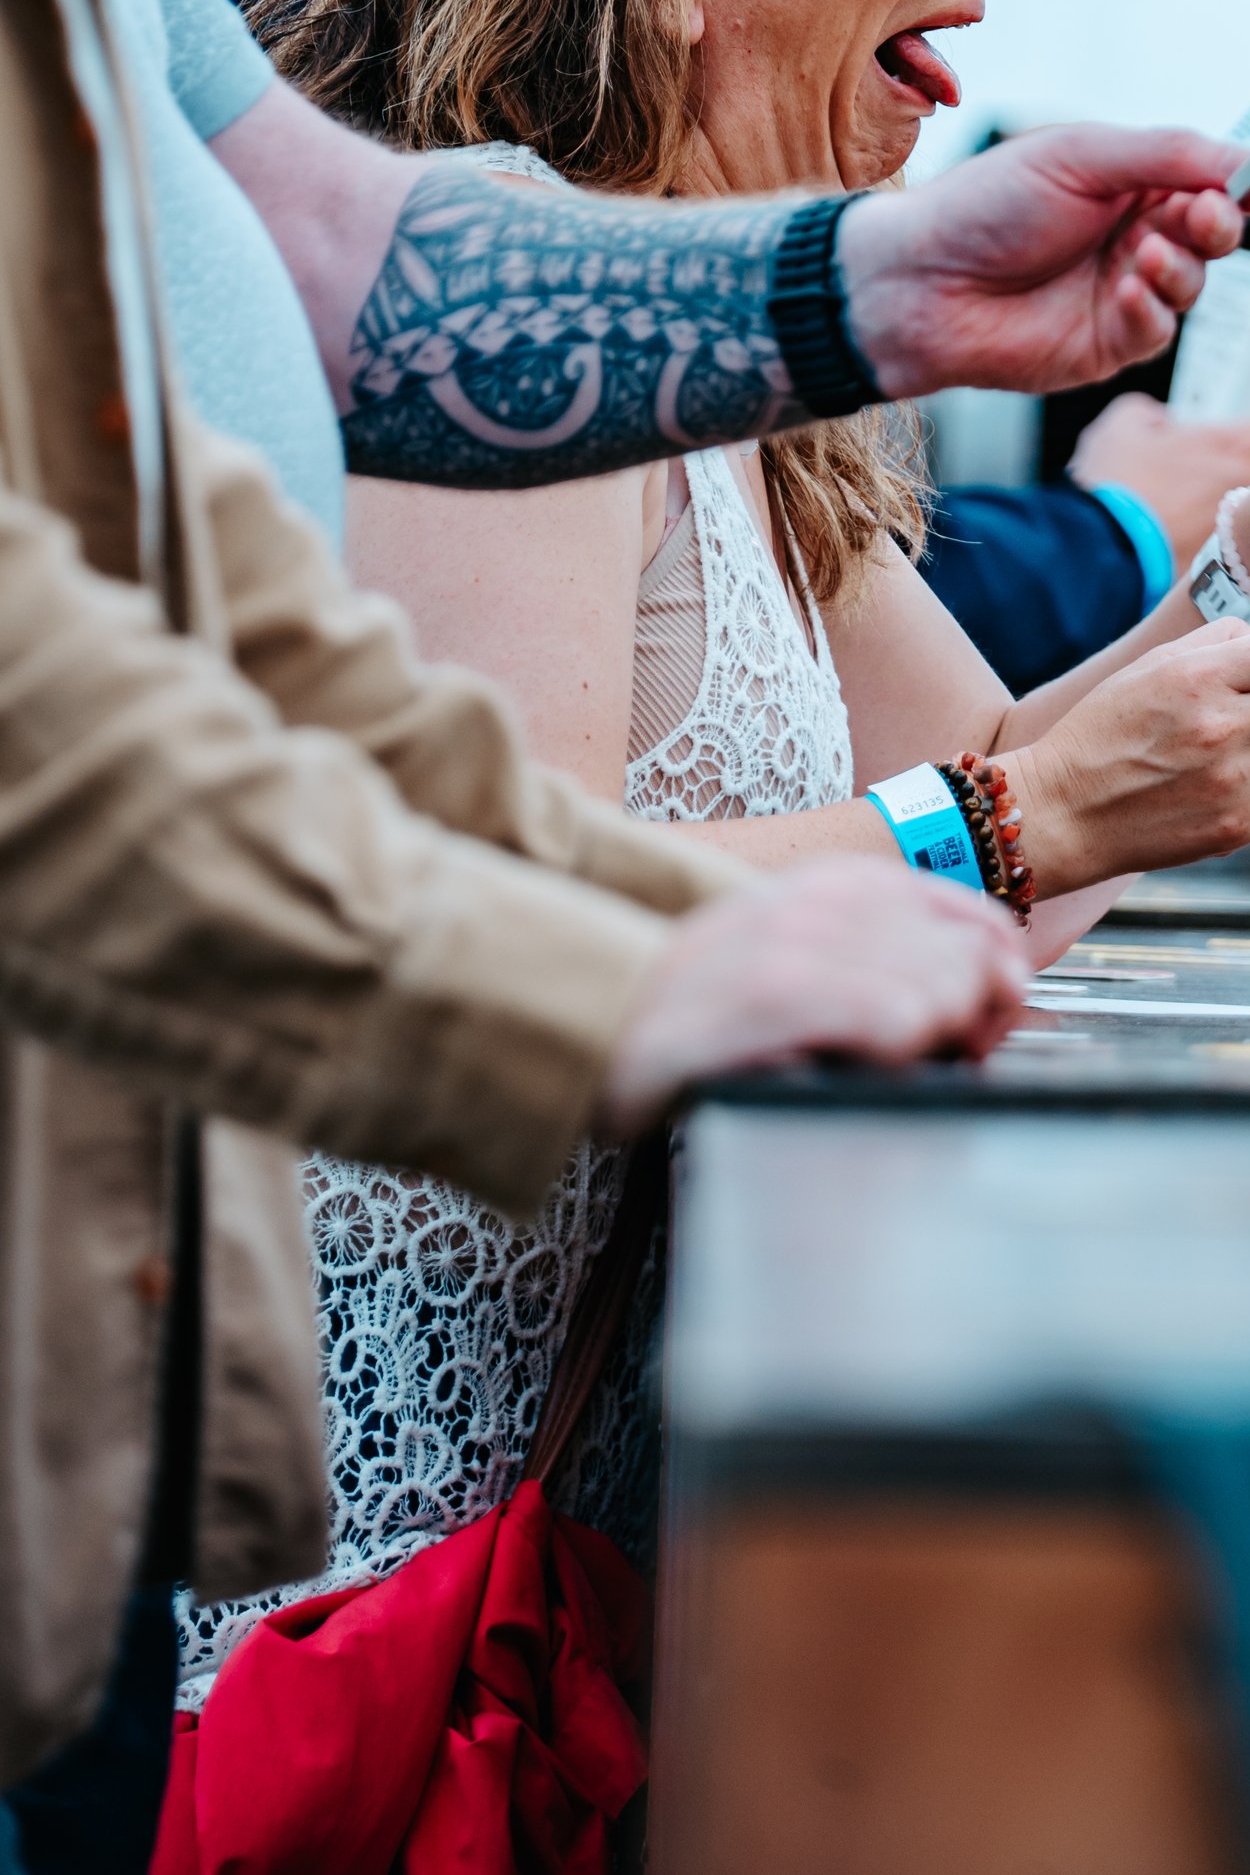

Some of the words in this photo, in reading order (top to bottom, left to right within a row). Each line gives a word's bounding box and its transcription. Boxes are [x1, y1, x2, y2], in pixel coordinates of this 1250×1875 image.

[901, 795, 944, 815] 623135
[935, 847, 949, 869] CIDER
[943, 836, 962, 867] BEER
[955, 833, 969, 864] TYNEDALE
